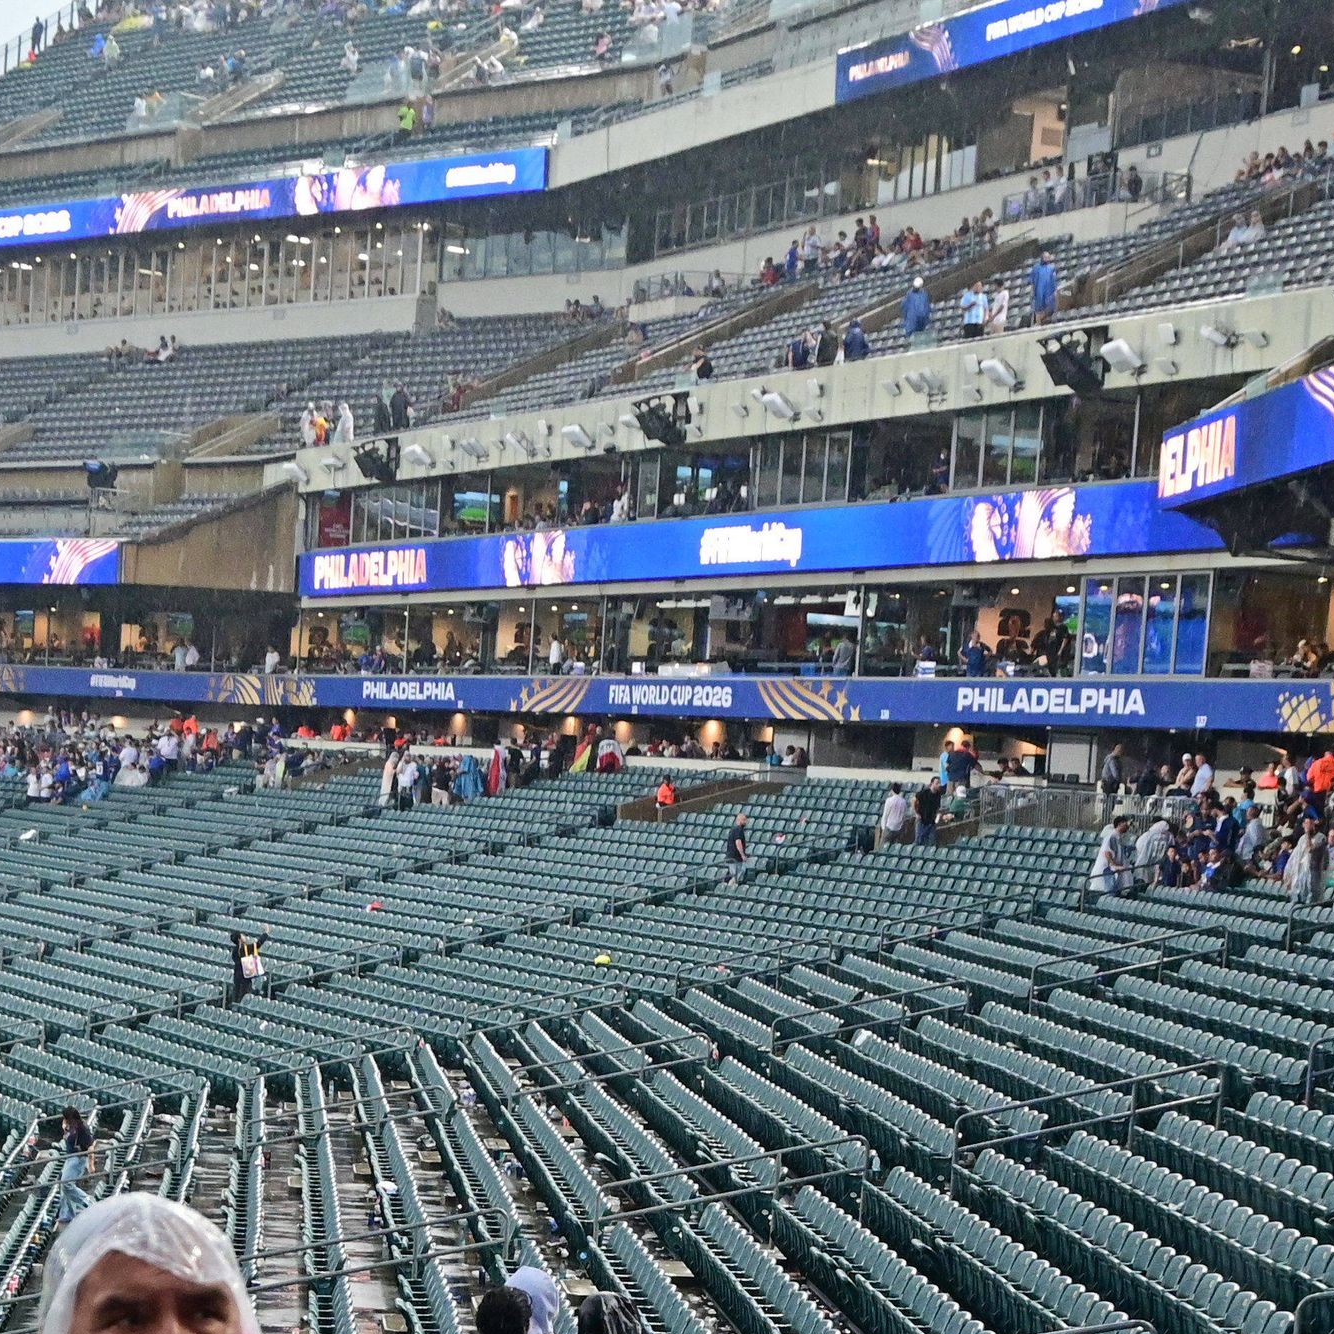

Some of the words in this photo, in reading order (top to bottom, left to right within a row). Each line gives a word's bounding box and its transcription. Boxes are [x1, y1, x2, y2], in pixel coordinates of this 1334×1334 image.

[167, 189, 271, 218] PHILADELPHIA
[313, 548, 427, 590] PHILADELPHIA
[362, 681, 455, 700] PHILADELPHIA
[608, 685, 630, 705] FIFA
[631, 686, 670, 705] WORLD
[670, 687, 692, 706] CUP
[693, 687, 733, 707] 2026
[957, 687, 1146, 715] PHILADELPHIA
